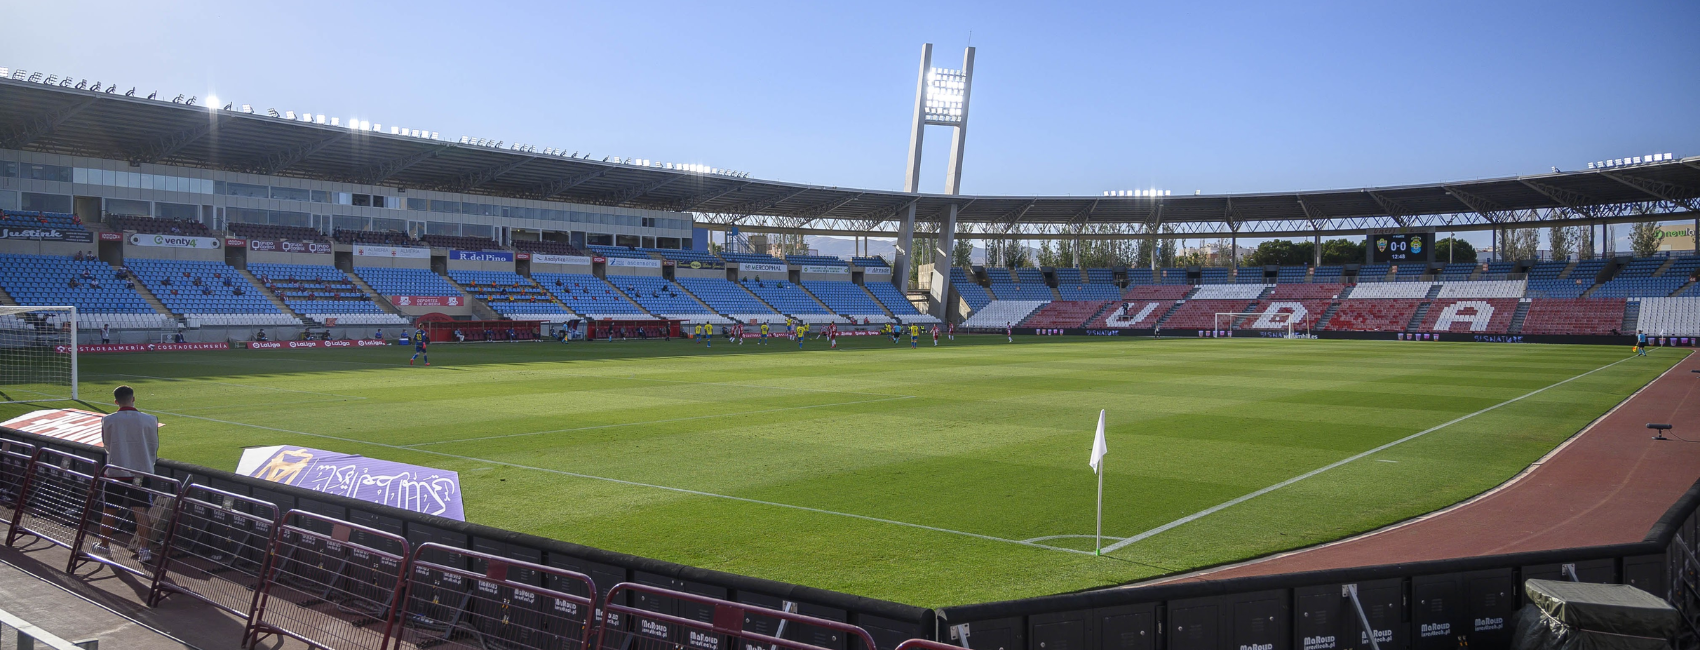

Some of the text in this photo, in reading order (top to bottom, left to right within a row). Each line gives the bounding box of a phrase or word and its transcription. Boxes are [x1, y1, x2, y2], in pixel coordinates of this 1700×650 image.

[165, 236, 197, 247] venty4
[1106, 301, 1495, 331] U D A
[1361, 629, 1392, 639] MRoLED
